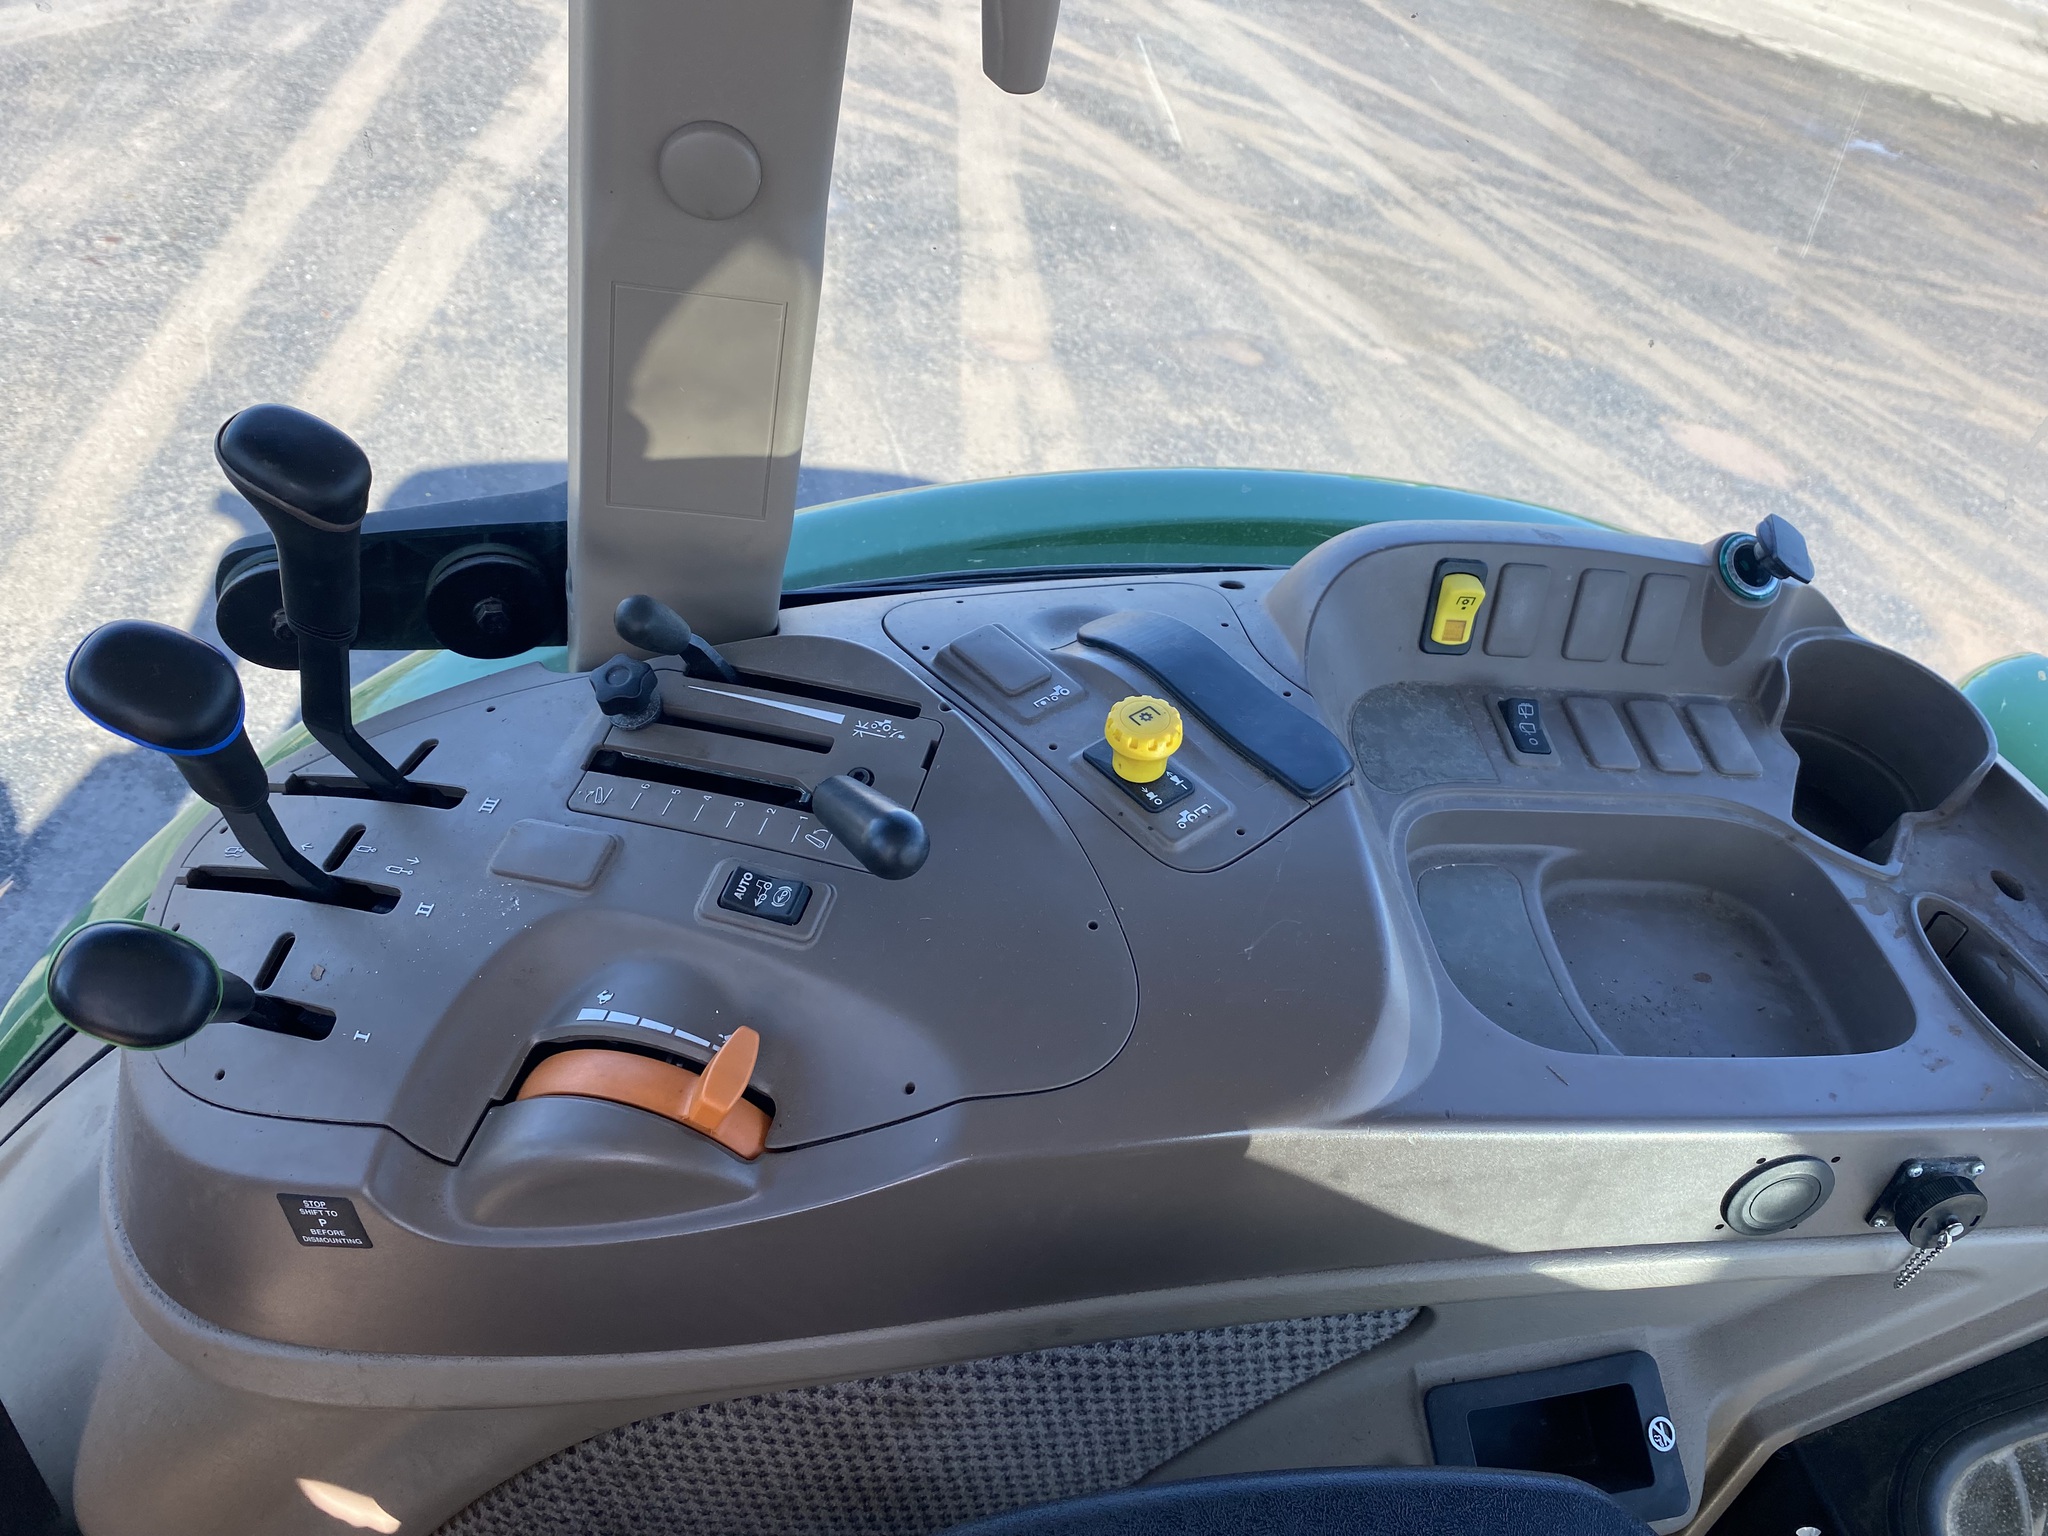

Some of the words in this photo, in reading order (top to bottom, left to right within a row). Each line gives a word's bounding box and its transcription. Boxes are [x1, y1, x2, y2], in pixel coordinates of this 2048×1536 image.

[733, 871, 754, 901] AUTO
[302, 1200, 326, 1208] STOP
[299, 1208, 324, 1216] SHIFT
[318, 1218, 327, 1227] P
[310, 1228, 346, 1236] BEFORE
[302, 1235, 363, 1245] DISMOUNTING
